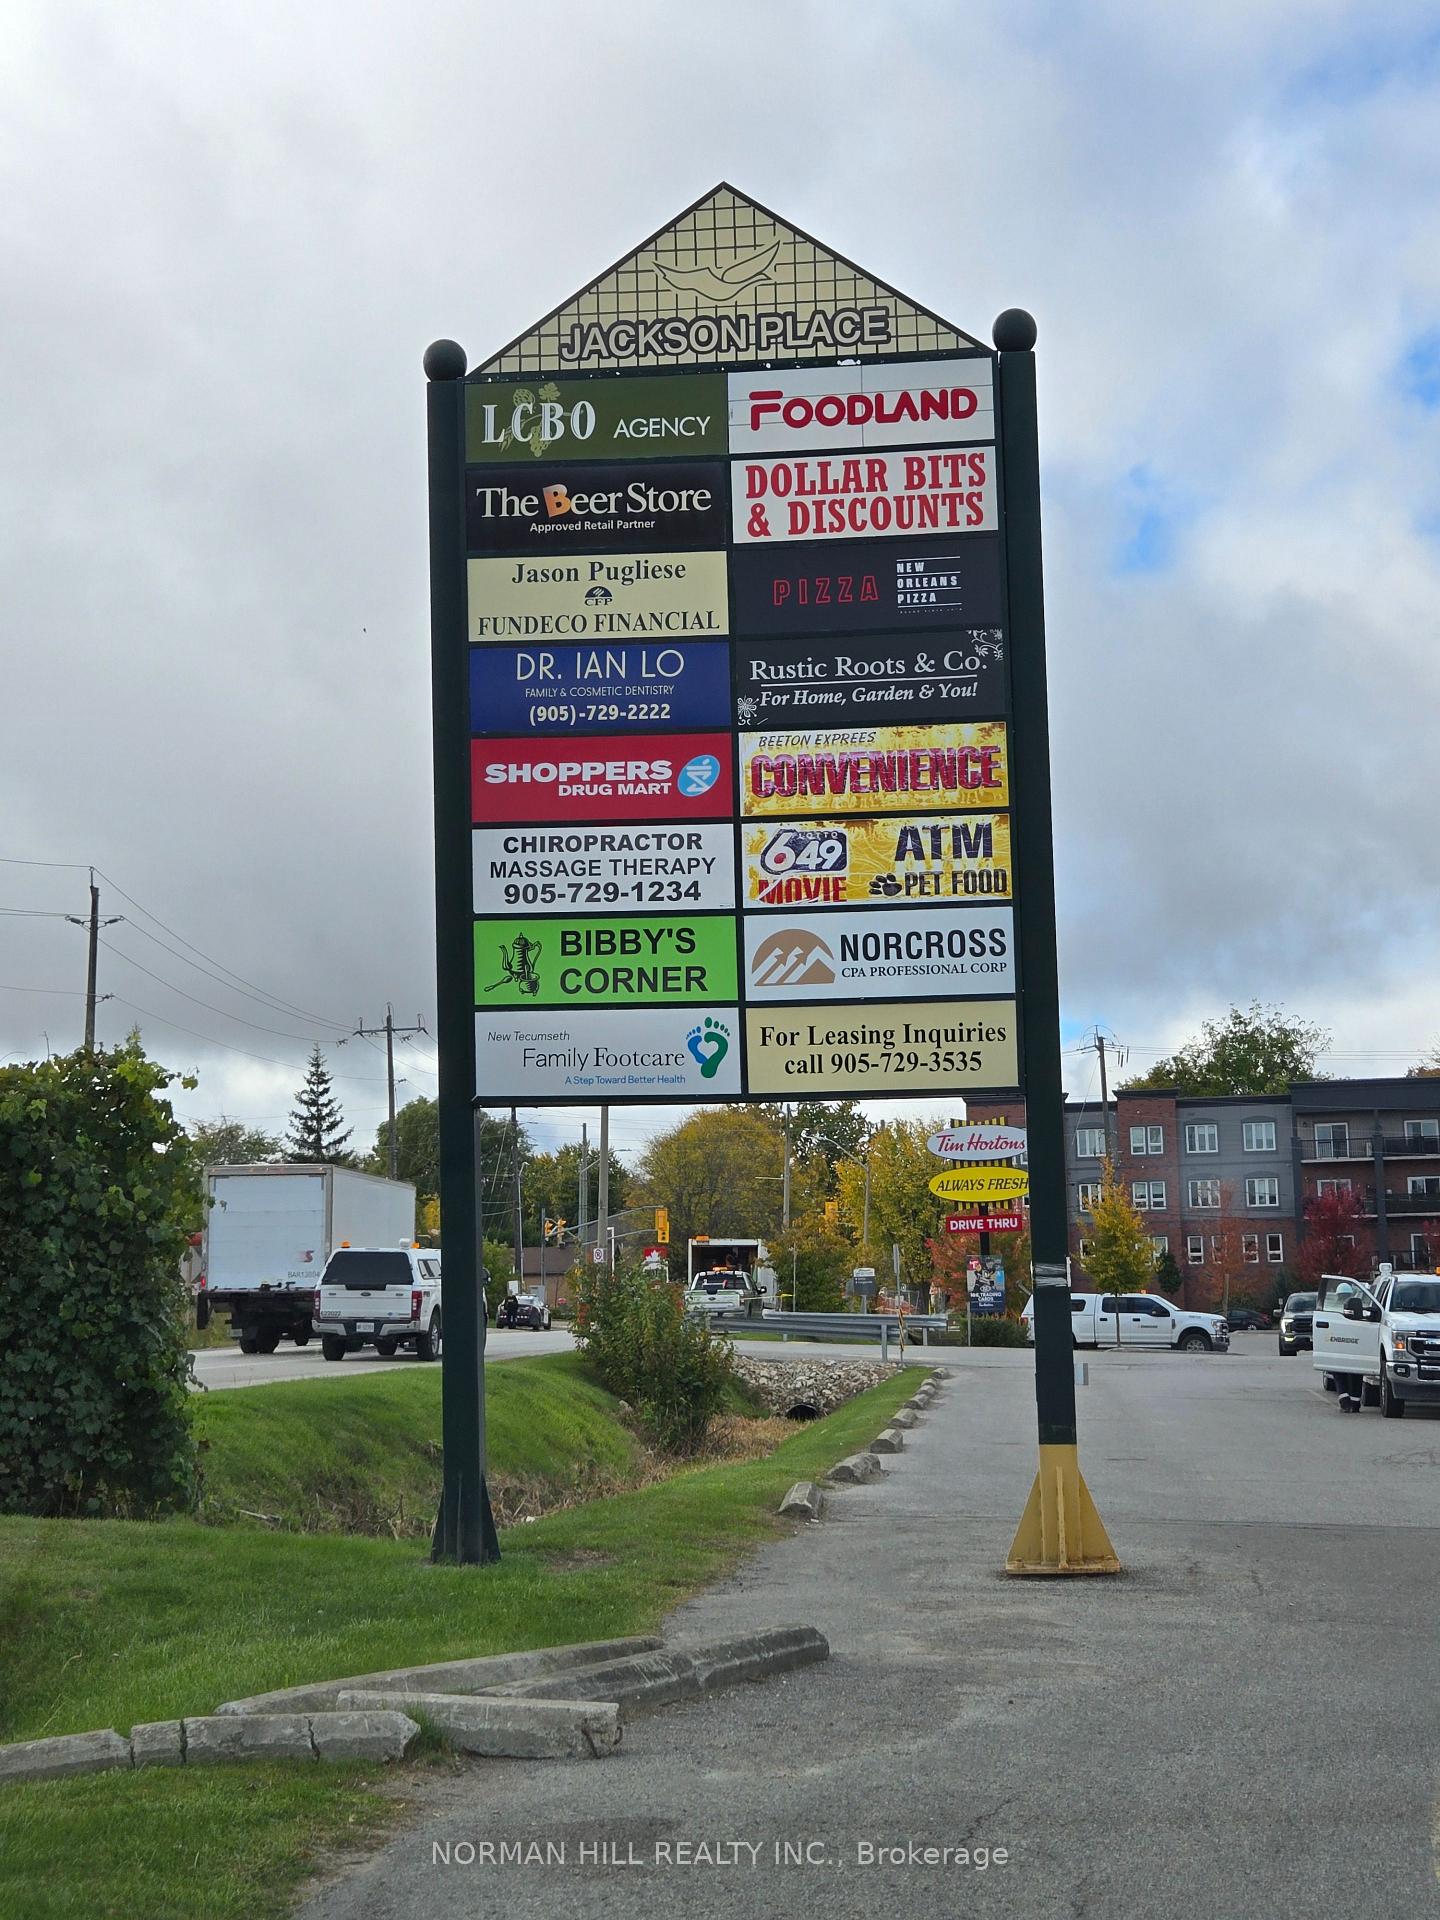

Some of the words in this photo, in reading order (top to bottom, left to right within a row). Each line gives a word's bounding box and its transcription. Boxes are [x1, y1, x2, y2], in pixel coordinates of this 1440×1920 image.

[560, 315, 749, 361] JACKSON
[760, 307, 889, 350] PLACE
[749, 388, 978, 431] FOODLAND
[481, 400, 597, 444] LCBO
[613, 416, 711, 438] AGENCY
[745, 458, 888, 499] DOLLAR
[903, 452, 986, 491] BITS
[476, 487, 539, 518] The
[543, 483, 622, 518] Beer
[626, 482, 712, 514] Store
[530, 521, 582, 533] Approved
[584, 520, 614, 530] Retail
[616, 519, 655, 530] Partner
[747, 502, 771, 537] &
[787, 491, 984, 536] DISCOUNTS
[512, 563, 580, 584] Jason
[588, 560, 686, 586] Pugliese
[896, 561, 925, 573] NEW
[773, 575, 879, 606] PIZZA
[897, 575, 958, 589] ORLEANS
[584, 597, 613, 606] CFP
[897, 592, 936, 604] PIZZA
[478, 614, 587, 636] FUNDECO
[594, 610, 720, 633] FINANCIAL
[516, 652, 562, 681] DR.
[576, 651, 626, 679] IAN
[642, 649, 685, 678] LO
[749, 657, 827, 680] Rustic
[834, 656, 906, 677] Roots
[913, 652, 936, 673] &
[943, 650, 987, 671] Co.
[525, 687, 558, 698] FAMILY
[559, 687, 567, 697] &
[569, 686, 622, 697] COSMETIC
[625, 685, 674, 696] DENTISTRY
[759, 690, 789, 707] For
[792, 689, 847, 706] Home,
[852, 685, 914, 702] Garden
[918, 684, 934, 699] &
[939, 682, 978, 698] You!
[529, 703, 671, 726] (905)-729-2222
[758, 734, 811, 748] BEETON
[815, 731, 876, 745] EXPREES
[484, 760, 673, 784] SHOPPERS
[750, 745, 1002, 798] CONVENIENCE
[558, 783, 612, 797] DRUG
[617, 782, 672, 796] MART
[503, 832, 703, 854] CHIROPRACTOR
[798, 831, 838, 840] LOTTO
[894, 822, 992, 862] ATM
[490, 859, 601, 879] MASSAGE
[609, 857, 716, 876] THERAPY
[504, 880, 701, 904] 905-729-1234
[758, 876, 847, 904] MOVIE
[904, 870, 943, 896] PET
[952, 868, 1007, 895] FOOD
[560, 927, 696, 956] BIBBY'S
[840, 928, 1007, 962] NORCROSS
[559, 965, 708, 994] CORNER
[841, 967, 866, 978] CPA
[870, 964, 968, 977] PROFESSIONAL
[970, 962, 1007, 974] CORP
[487, 1031, 511, 1042] New
[513, 1030, 570, 1042] Tecumseth
[759, 1026, 800, 1047] For
[807, 1024, 896, 1049] Leasing
[903, 1021, 1007, 1048] Inquiries
[523, 1048, 588, 1071] Family
[593, 1047, 685, 1067] Footcare
[784, 1053, 824, 1074] call
[831, 1050, 982, 1074] 905-729-3535
[564, 1076, 572, 1085] A
[573, 1075, 594, 1086] Step
[595, 1075, 626, 1085] Toward
[628, 1075, 656, 1084] Better
[657, 1075, 685, 1084] Health
[936, 1134, 964, 1152] Tim
[967, 1133, 1025, 1151] Hortons
[936, 1178, 986, 1192] ALWAYS
[987, 1177, 1029, 1190] FRESH
[950, 1219, 984, 1230] DRIVE
[988, 1217, 1018, 1229] THRU
